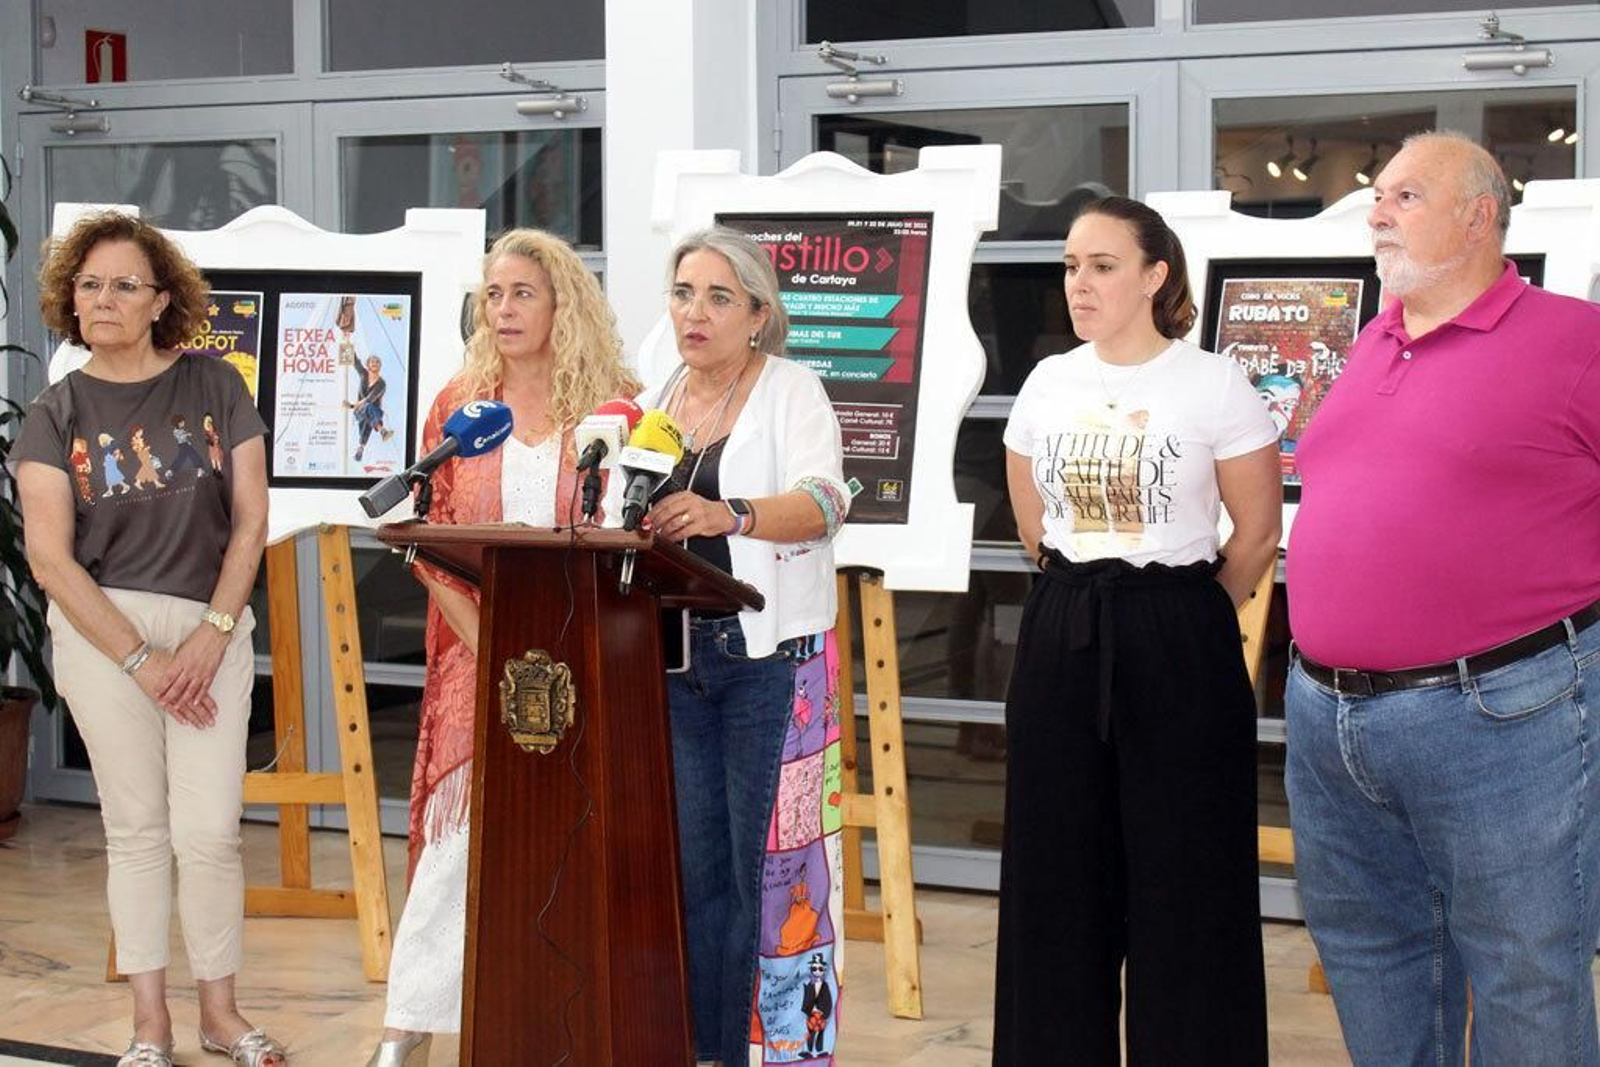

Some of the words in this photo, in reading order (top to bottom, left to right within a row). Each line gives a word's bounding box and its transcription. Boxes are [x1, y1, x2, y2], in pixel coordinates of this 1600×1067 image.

[784, 231, 802, 241] del
[761, 235, 870, 273] astillo
[791, 273, 807, 284] de
[810, 274, 857, 287] Cartaya
[1228, 304, 1309, 322] RUBATO
[175, 334, 238, 351] GOFOT
[283, 328, 336, 343] ETXEA
[283, 342, 329, 359] CASA
[283, 358, 336, 374] HOME
[841, 371, 877, 379] concierto
[1158, 434, 1182, 459] &
[1035, 456, 1178, 487] GRATITUDE
[1105, 486, 1172, 506] PARTS
